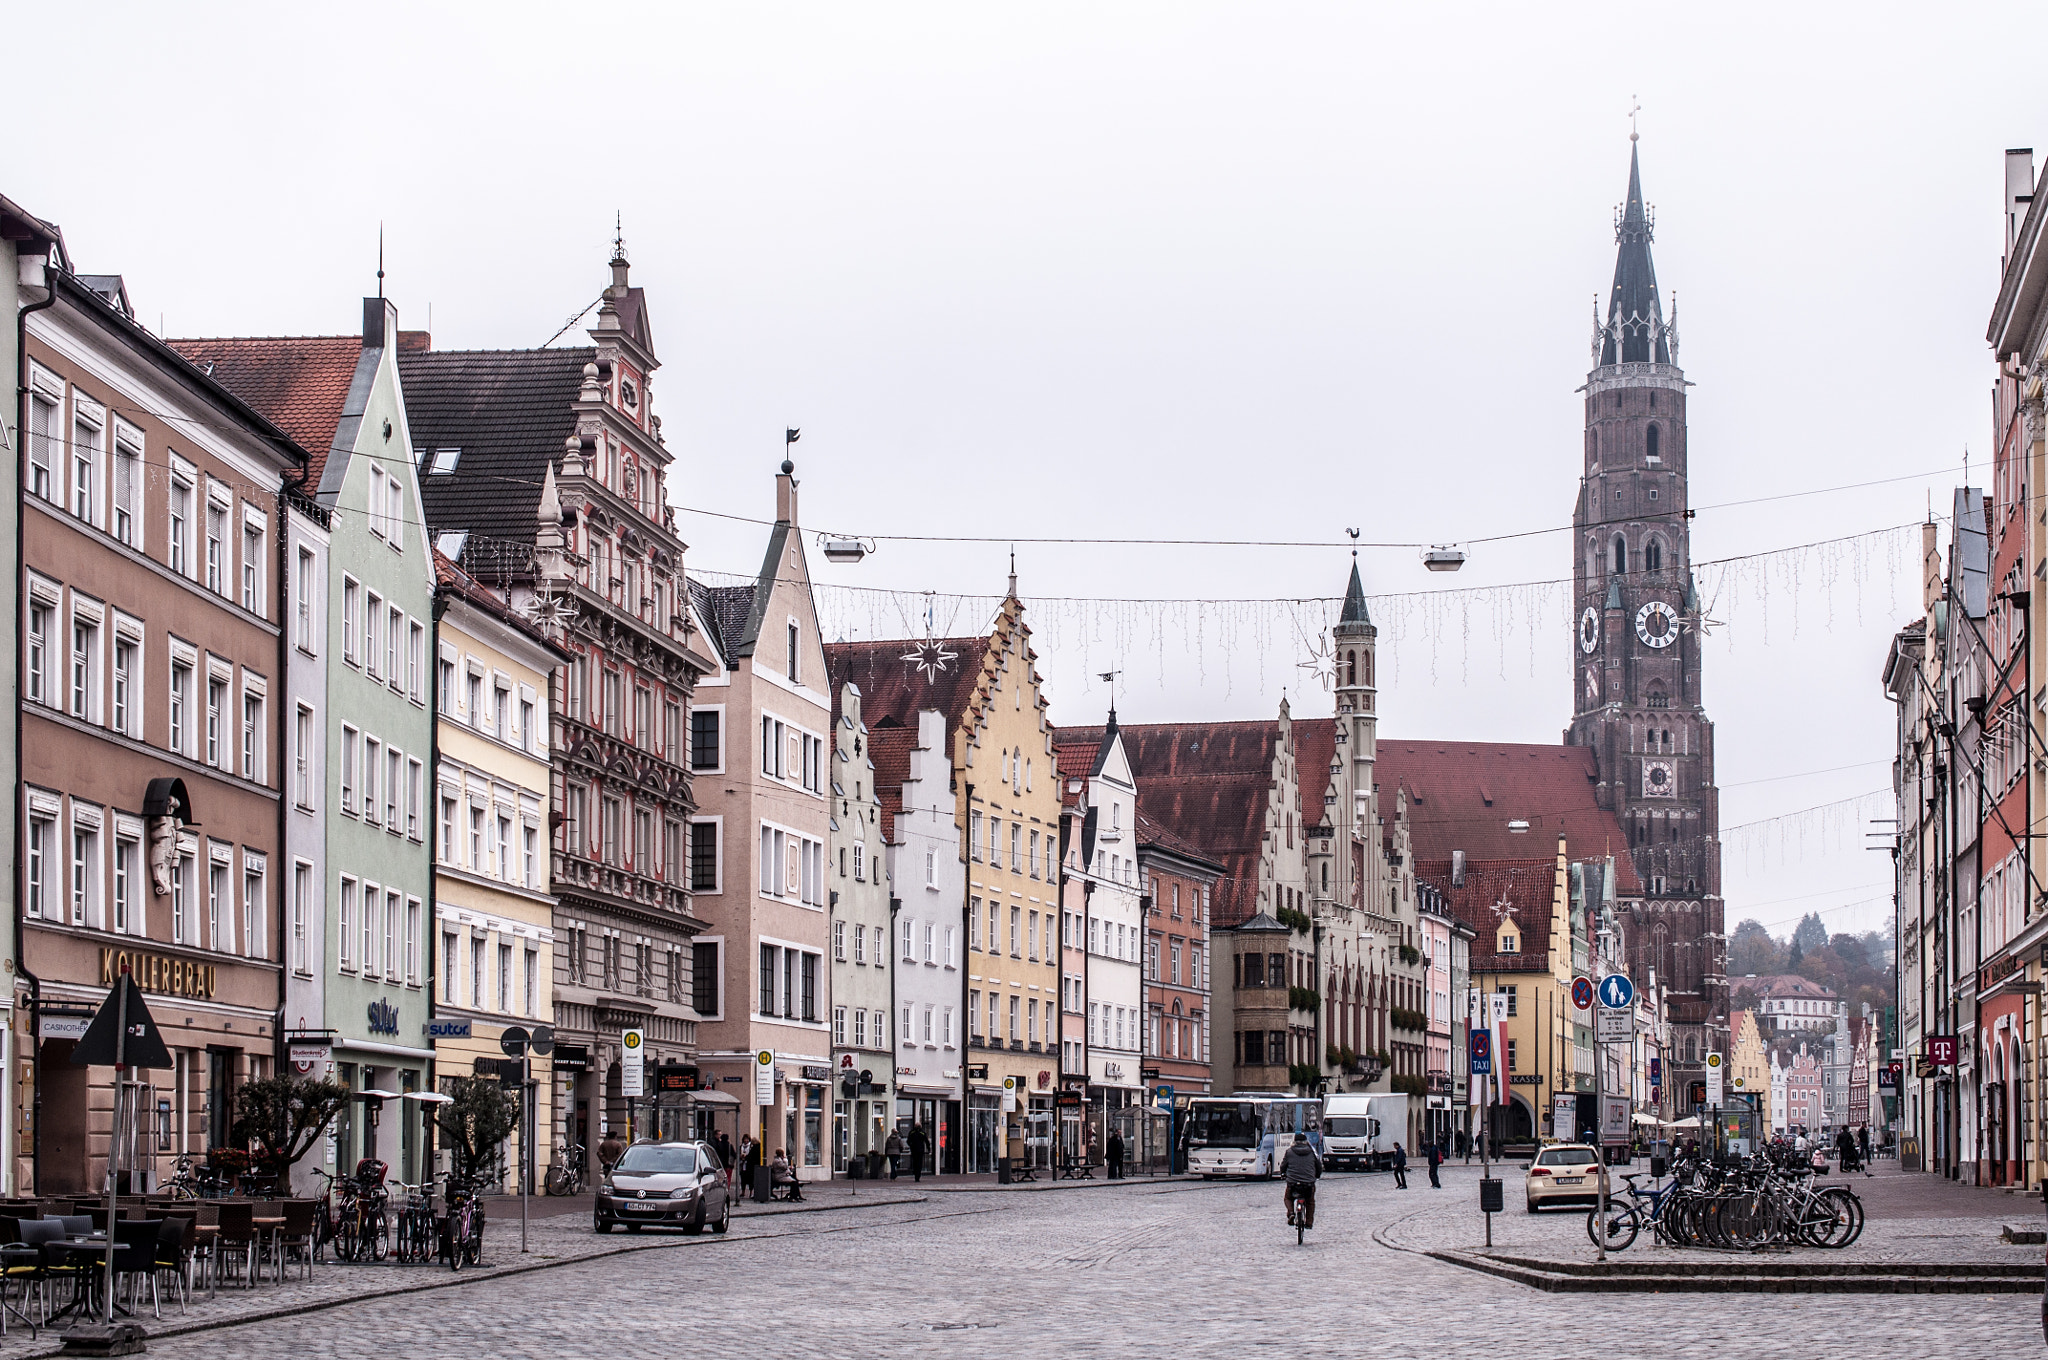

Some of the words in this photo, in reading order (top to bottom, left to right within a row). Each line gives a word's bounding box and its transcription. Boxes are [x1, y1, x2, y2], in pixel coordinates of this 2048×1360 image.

[1935, 1042, 1951, 1061] T
[1472, 1060, 1490, 1071] TAXI
[1490, 1075, 1542, 1083] SRKASSE
